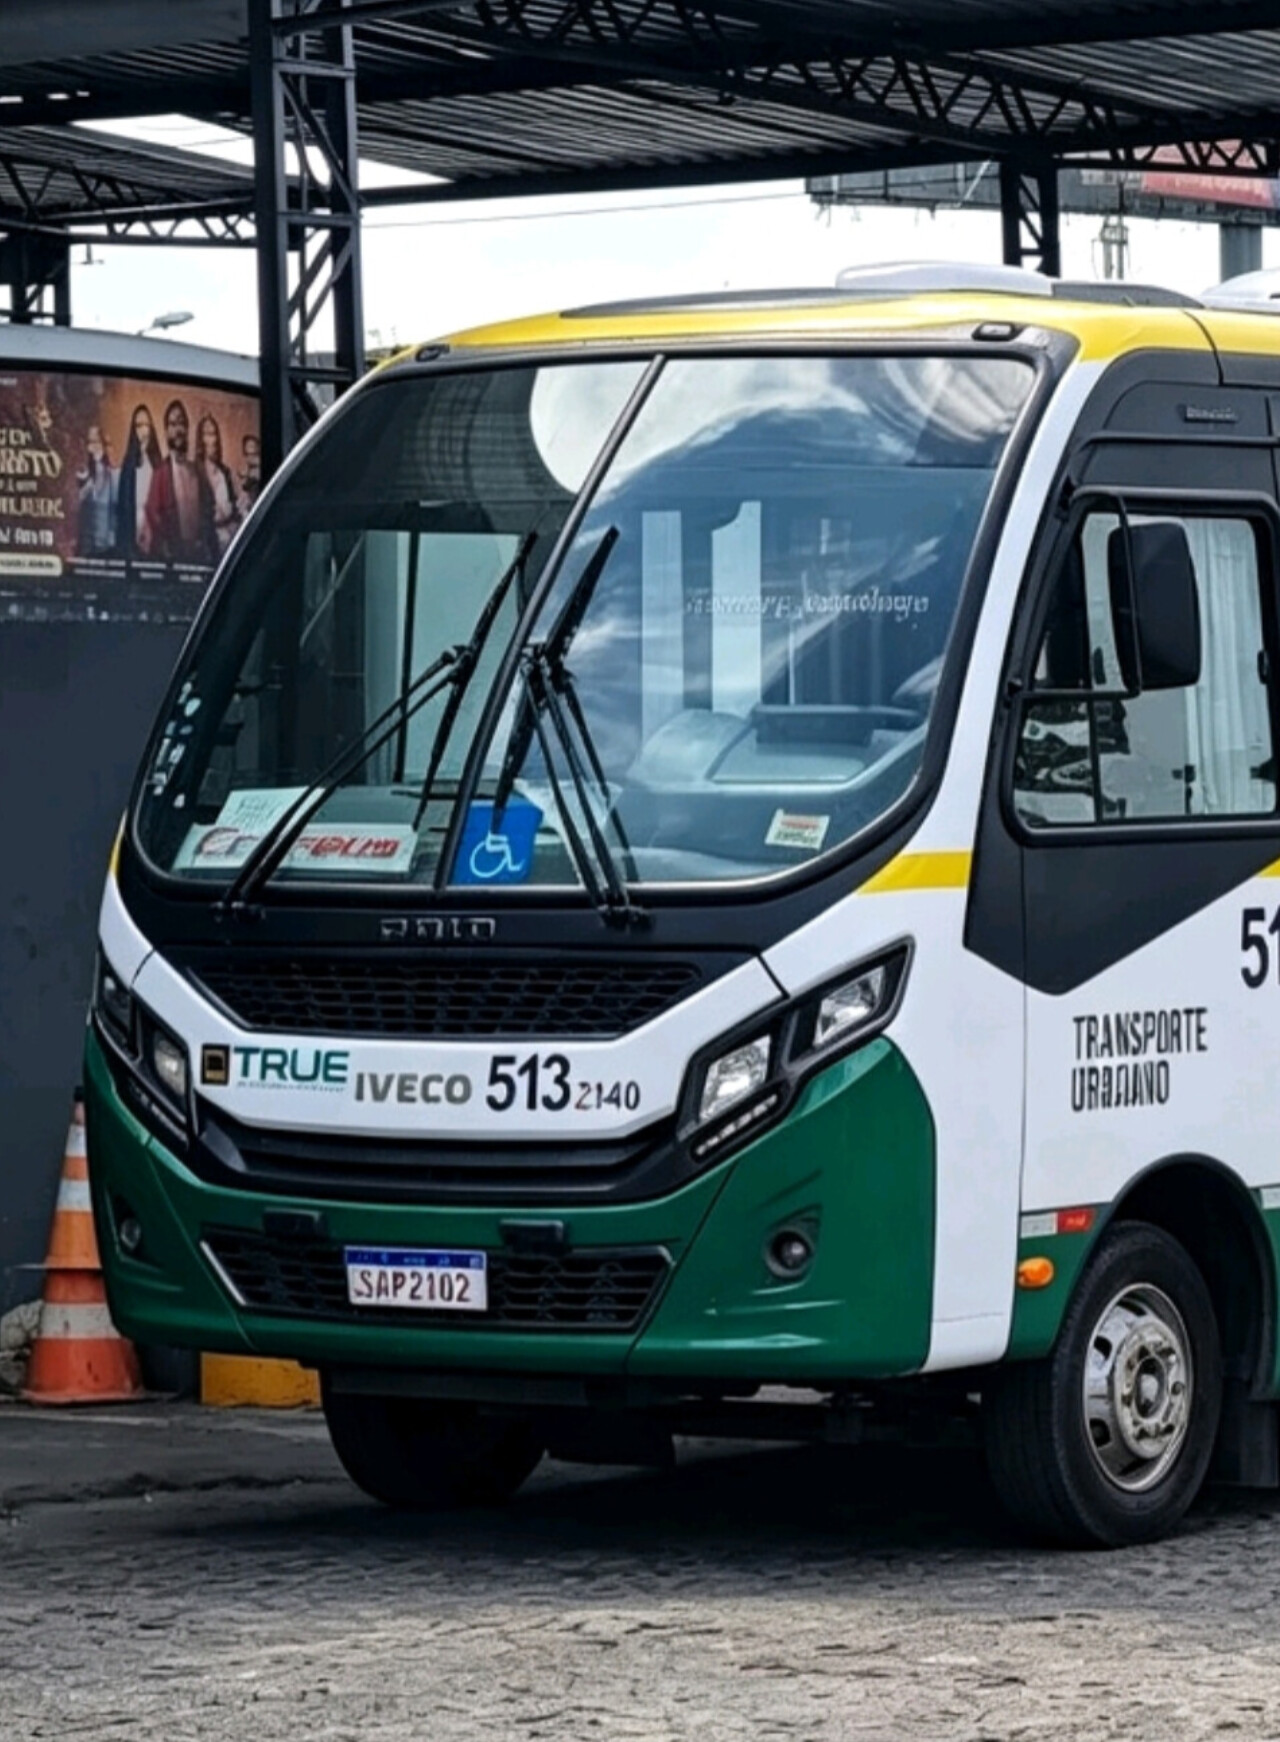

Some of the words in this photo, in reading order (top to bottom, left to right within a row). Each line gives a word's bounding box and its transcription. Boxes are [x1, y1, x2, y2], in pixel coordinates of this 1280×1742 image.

[1072, 1006, 1208, 1060] TRANSPORTE
[233, 1046, 350, 1084] TRUE
[485, 1052, 571, 1112] 513
[574, 1080, 641, 1111] 2140
[355, 1072, 473, 1105] IVECO
[353, 1268, 472, 1303] SAP2102
